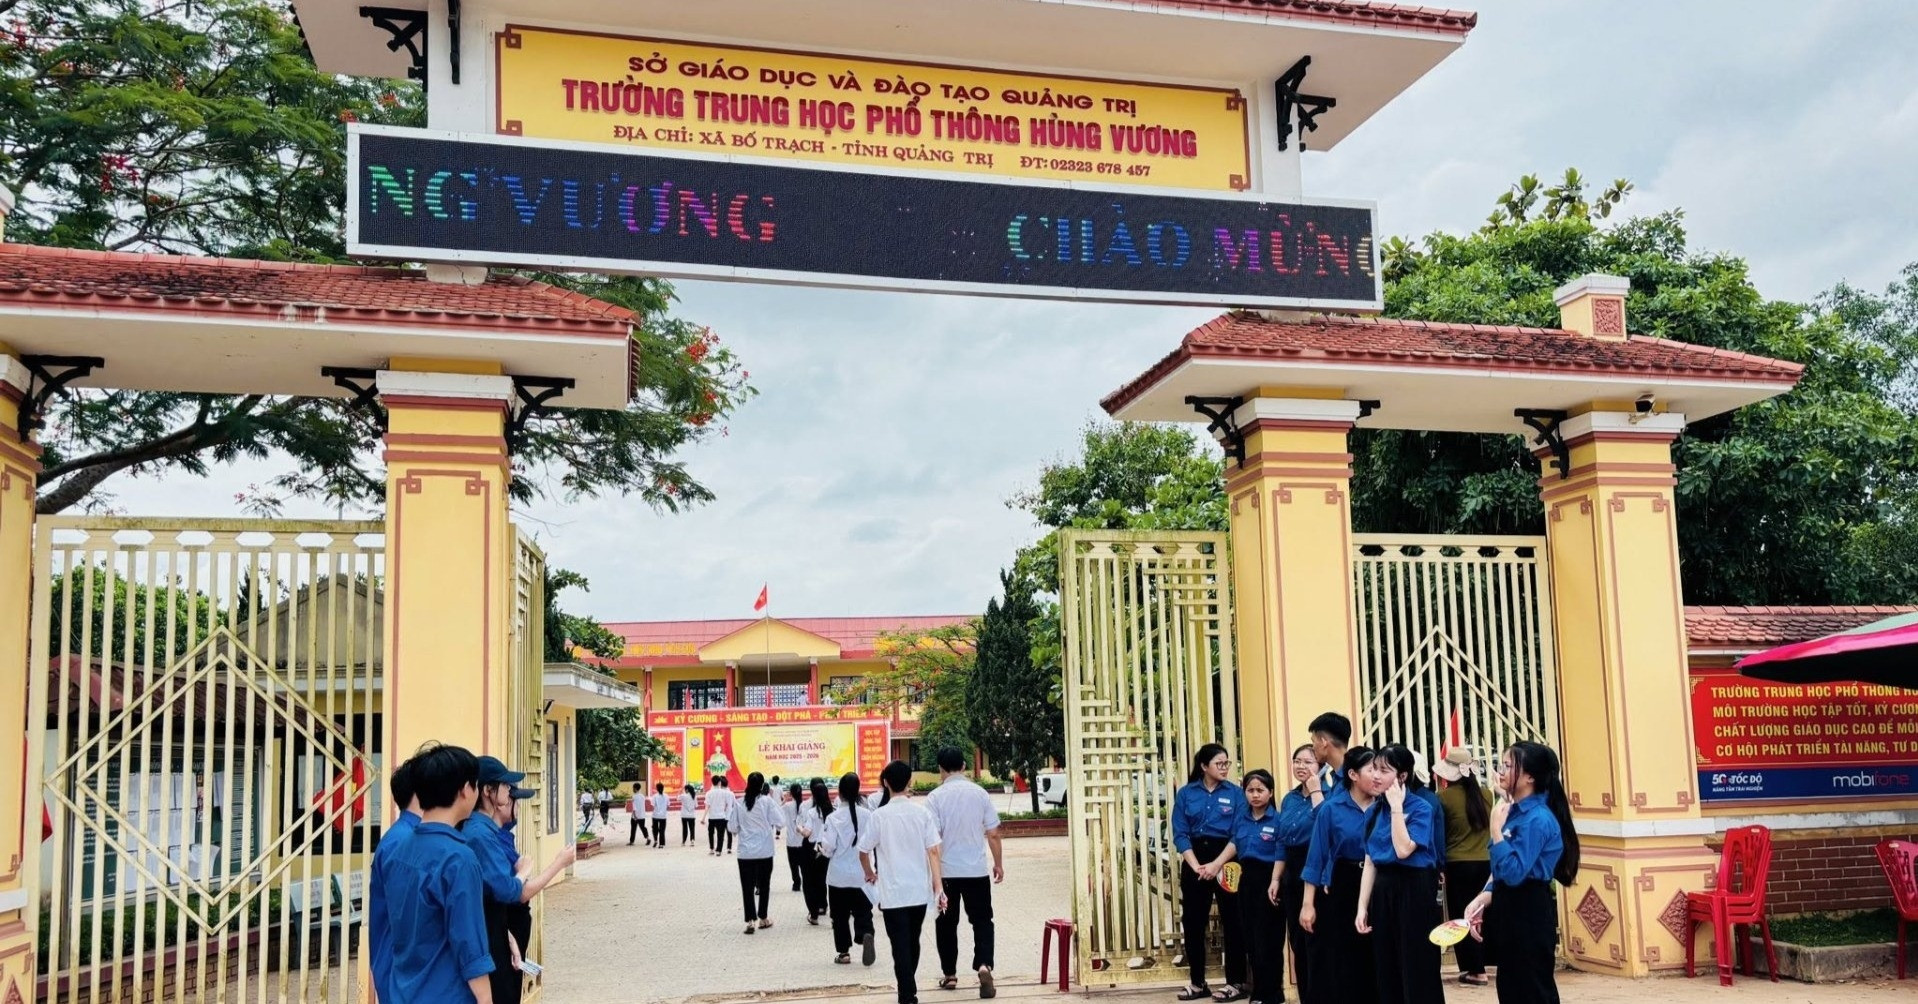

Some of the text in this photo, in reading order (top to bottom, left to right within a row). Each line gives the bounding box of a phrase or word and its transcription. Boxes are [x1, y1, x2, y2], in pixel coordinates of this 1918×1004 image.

[628, 51, 1138, 117] SỞ GIÁO DỤC VÀ ĐÀO TẠO QUẢNG TRỊ
[562, 75, 1198, 158] TRƯỜNG TRUNG HỌC PHỔ THÔNG HÙNG VƯƠNG
[613, 125, 648, 142] ĐỊA
[654, 126, 693, 142] CHỈ:
[699, 131, 726, 146] XÃ
[731, 131, 757, 148] BỐ
[762, 136, 825, 154] TRẠCH
[842, 140, 888, 158] TỈNH
[893, 144, 954, 162] QUẢNG
[963, 152, 994, 169] TRỊ
[1096, 162, 1122, 175] 678
[1126, 164, 1151, 176] 457
[501, 171, 777, 243] VƯƠNG
[1006, 203, 1191, 270] CHÀO
[1711, 684, 1760, 698] TRƯỜNG
[1763, 686, 1803, 697] TRUNG
[1807, 685, 1831, 699] HỌC
[1835, 680, 1859, 697] PHỔ
[725, 710, 750, 723] SÁNG
[751, 711, 768, 724] TẠO
[1713, 703, 1737, 718] MÔI
[1740, 703, 1789, 717] TRƯỜNG
[1792, 705, 1817, 719] HỌC
[1821, 703, 1843, 719] TẬP
[1846, 701, 1871, 717] TỐT,
[1714, 721, 1746, 737] CHẤT
[1749, 722, 1790, 738] LƯỢNG
[1793, 721, 1821, 736] GIÁO
[1824, 723, 1849, 738] DỤC
[1852, 722, 1876, 735] CAO
[773, 743, 795, 752] KHAI
[1716, 743, 1733, 756] CƠ
[1737, 742, 1758, 758] HỘI
[1762, 741, 1793, 755] PHÁT
[1796, 738, 1830, 754] TRIỂN
[1833, 741, 1852, 754] TÀI
[1855, 740, 1890, 755] NĂNG,
[1892, 740, 1908, 752] TƯ
[1832, 770, 1909, 787] mobifone
